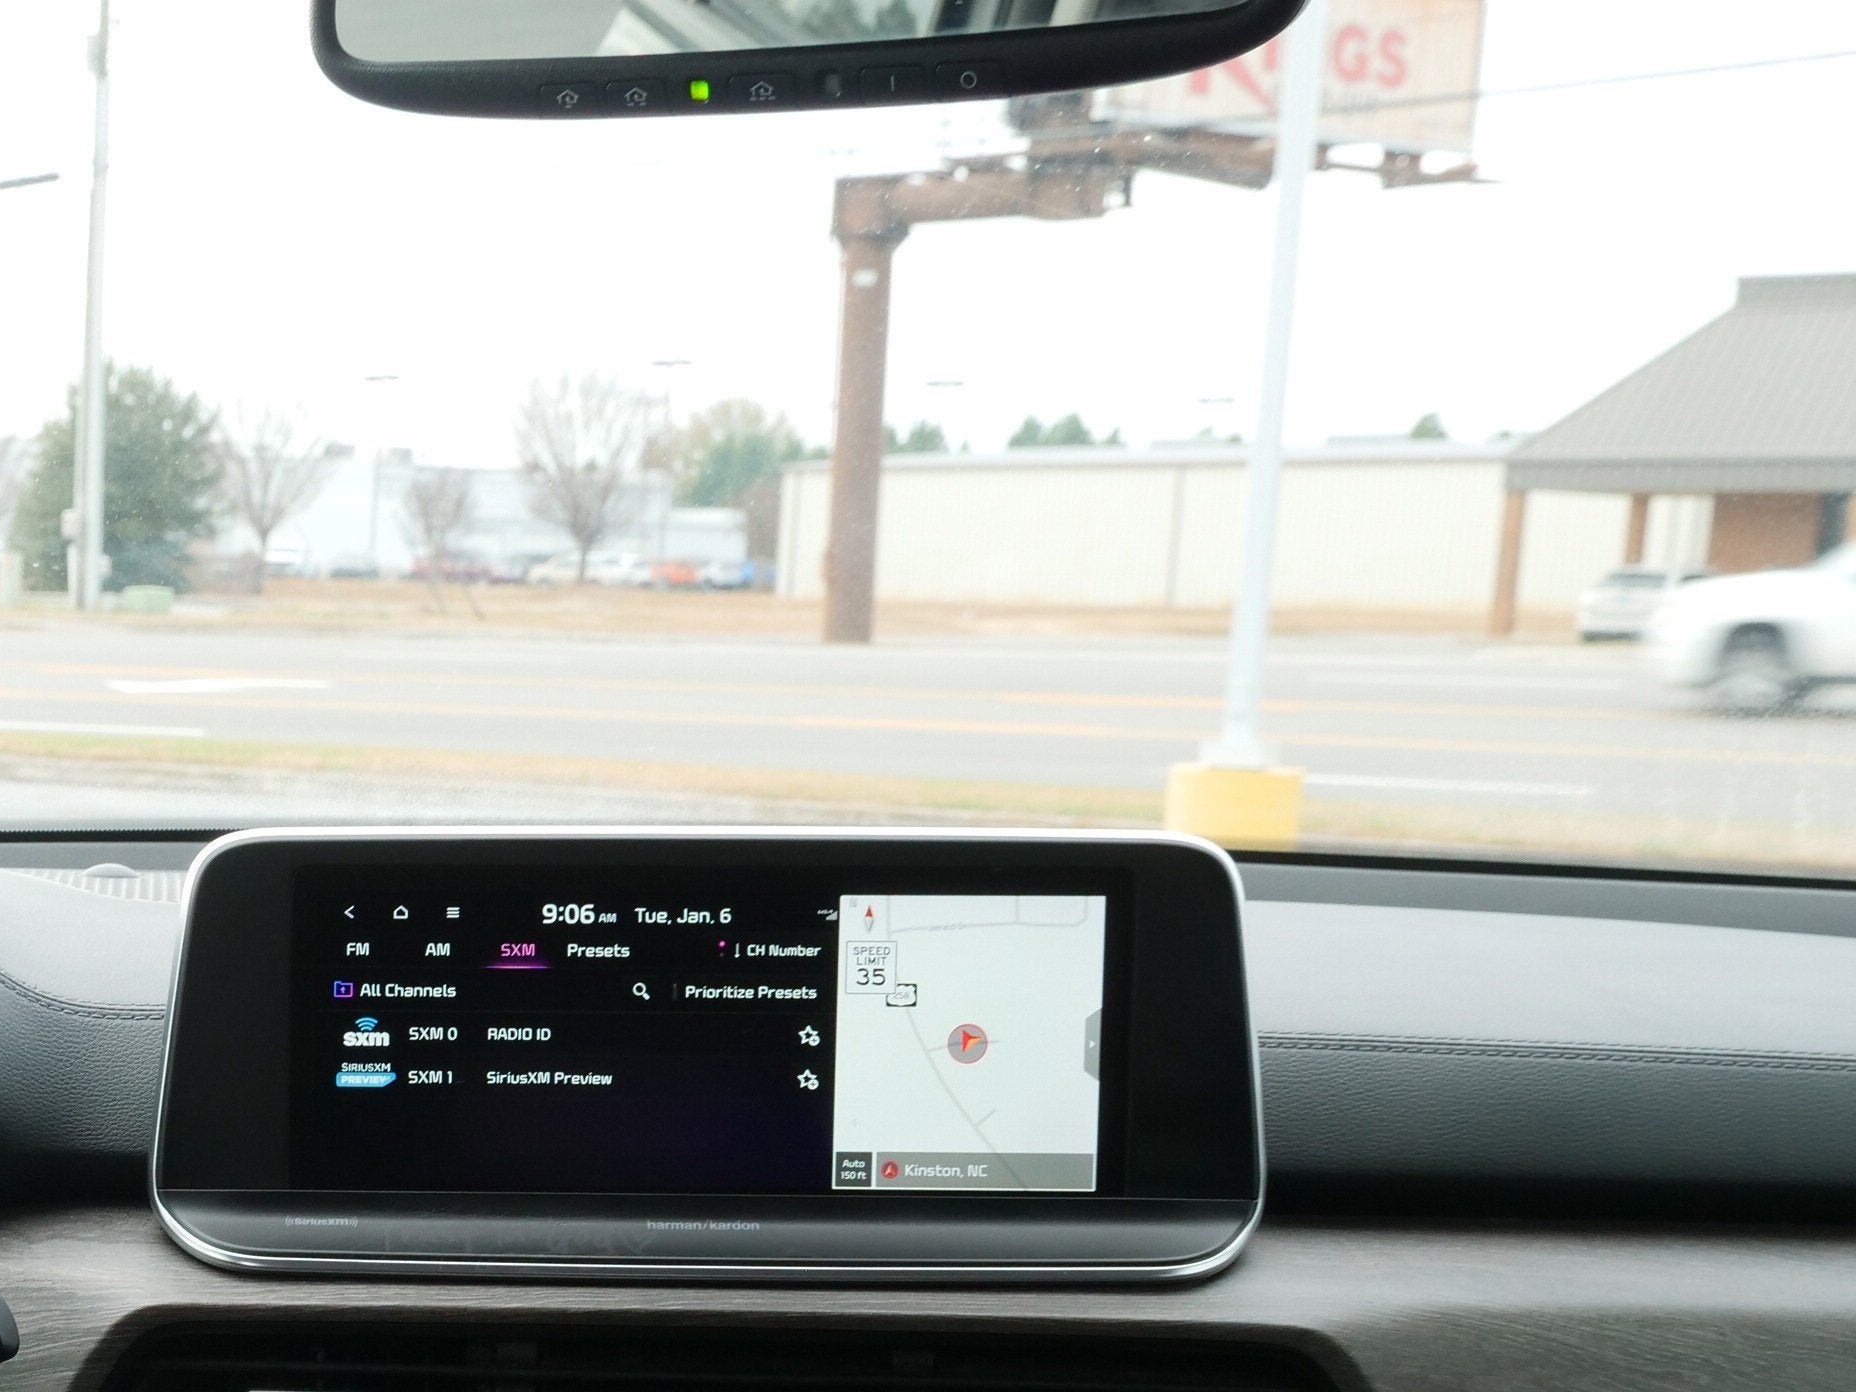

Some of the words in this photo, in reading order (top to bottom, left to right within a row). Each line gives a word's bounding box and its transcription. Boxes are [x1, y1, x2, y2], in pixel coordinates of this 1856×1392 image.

[542, 904, 594, 925] 9:06
[599, 913, 616, 923] AM
[635, 908, 671, 925] Tue,
[677, 908, 715, 924] Jan.
[719, 908, 732, 923] 6
[346, 943, 370, 956] FM
[425, 943, 450, 956] AM
[501, 944, 536, 957] SXM
[567, 944, 630, 958] Presets
[748, 944, 766, 957] CH
[769, 944, 821, 957] Number
[853, 947, 890, 956] SPEED
[857, 957, 887, 966] LIMIT
[857, 969, 886, 986] 35
[360, 983, 381, 997] All
[385, 983, 456, 998] Channels
[685, 985, 754, 999] Prioritize
[758, 986, 817, 999] Presets
[344, 1031, 389, 1047] sxm
[409, 1028, 443, 1041] SXM
[448, 1027, 458, 1041] 0
[488, 1028, 533, 1041] RADIO
[537, 1028, 551, 1041] ID
[341, 1062, 391, 1072] SIRIUSXM
[408, 1071, 443, 1084] SXM
[447, 1071, 454, 1084] 1
[487, 1071, 550, 1085] SiriusXM
[554, 1072, 612, 1085] Preview
[842, 1160, 865, 1168] Auto
[841, 1171, 856, 1180] 150
[857, 1171, 867, 1180] ft
[905, 1164, 964, 1178] Kinston,
[968, 1164, 988, 1177] NC
